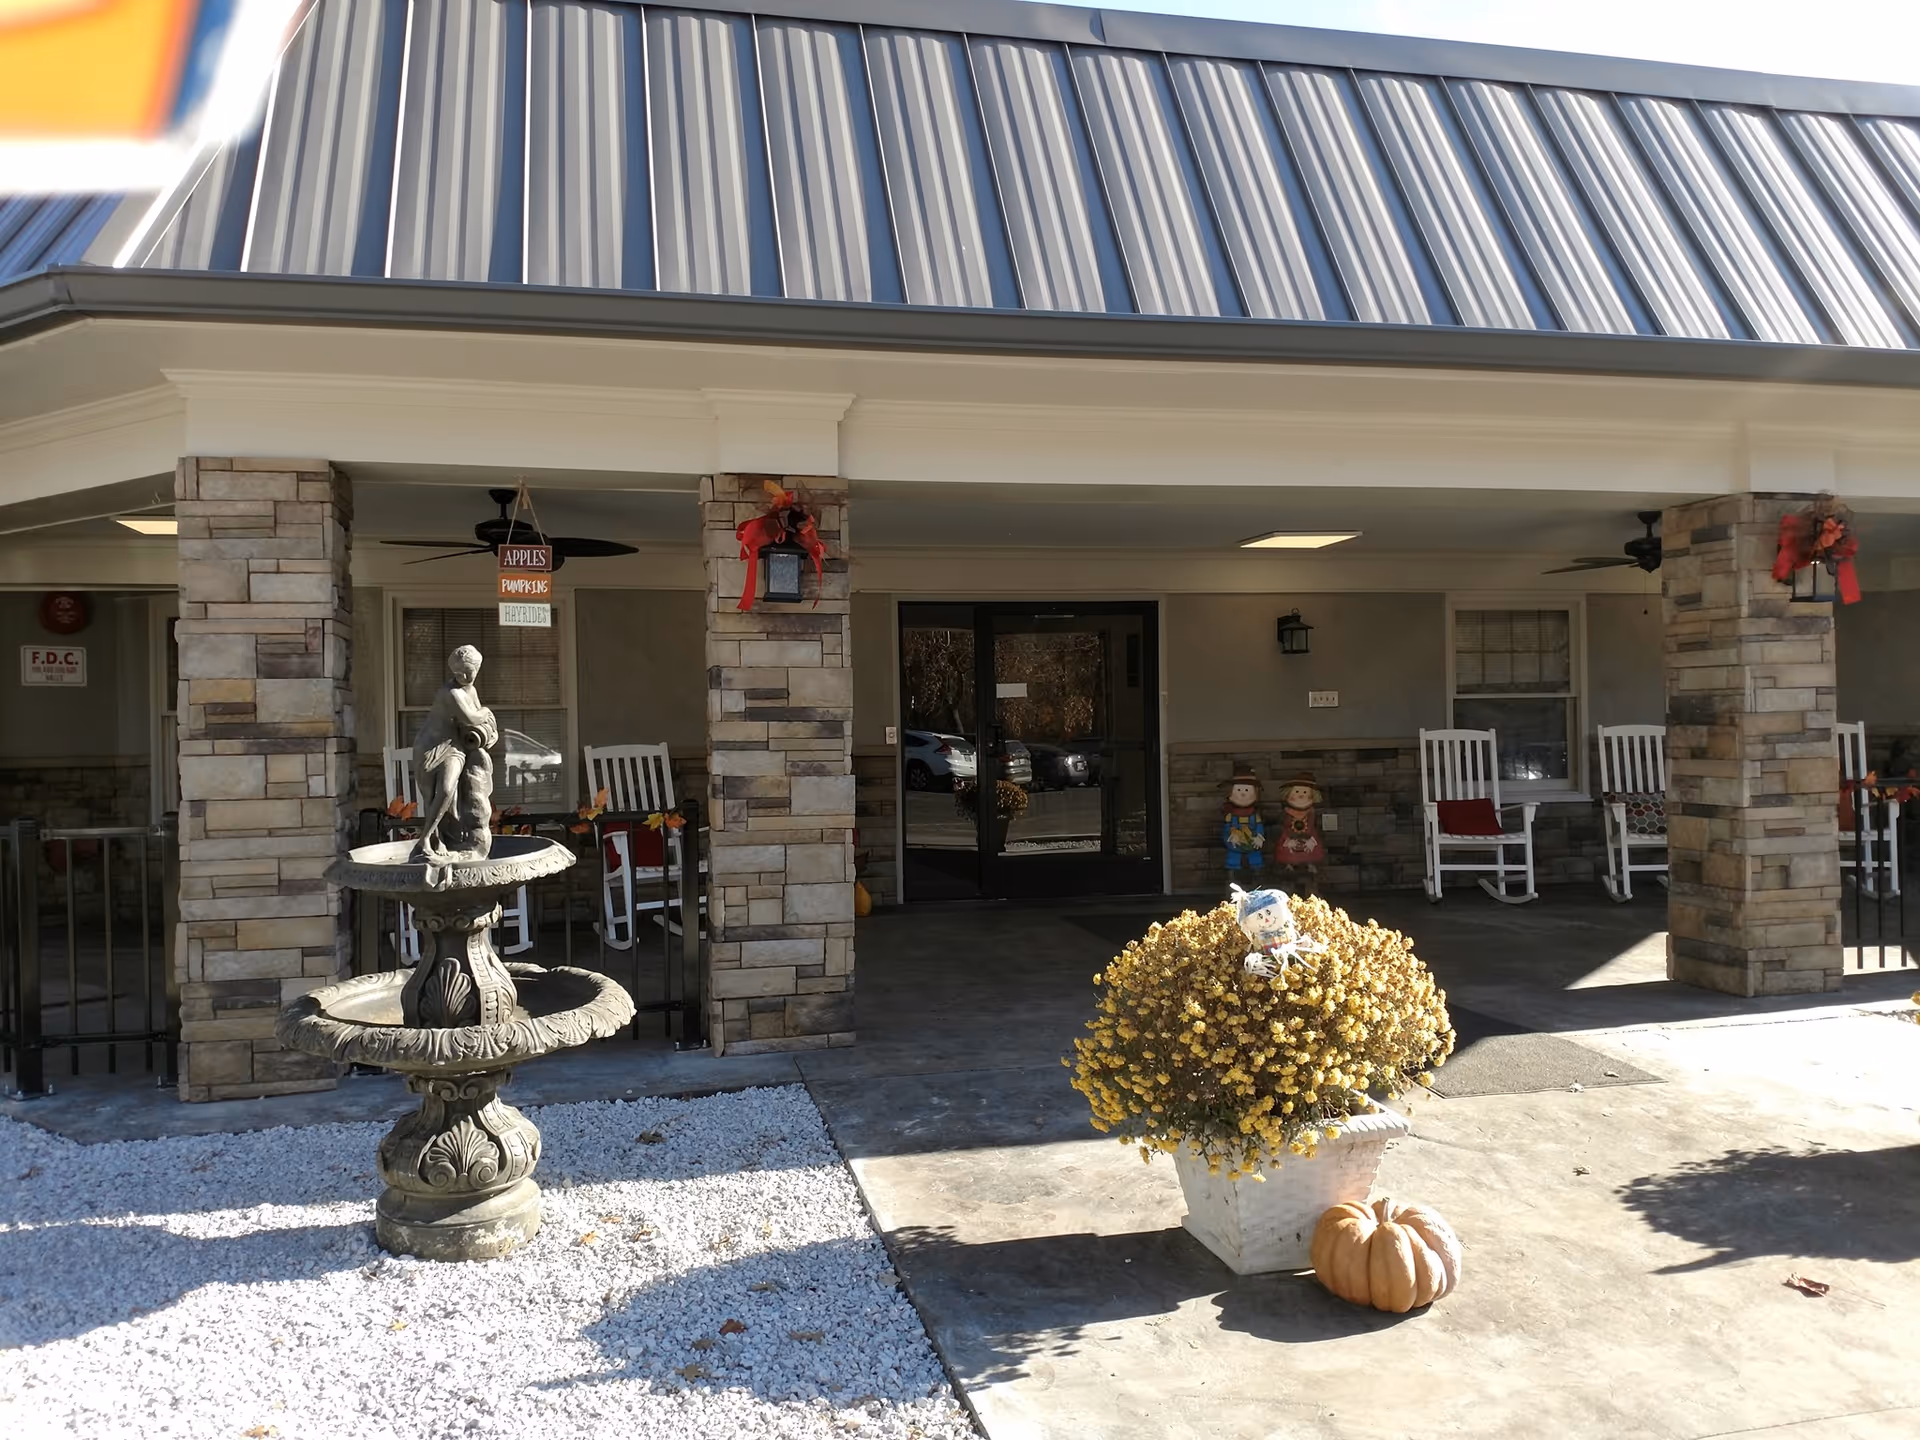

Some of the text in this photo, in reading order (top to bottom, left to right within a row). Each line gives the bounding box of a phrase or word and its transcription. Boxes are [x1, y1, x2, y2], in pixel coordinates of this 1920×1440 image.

[504, 549, 546, 566] APPLES
[502, 578, 548, 594] PUMPKINS
[504, 605, 547, 623] HAYRIDES
[32, 651, 79, 665] F.D.C.
